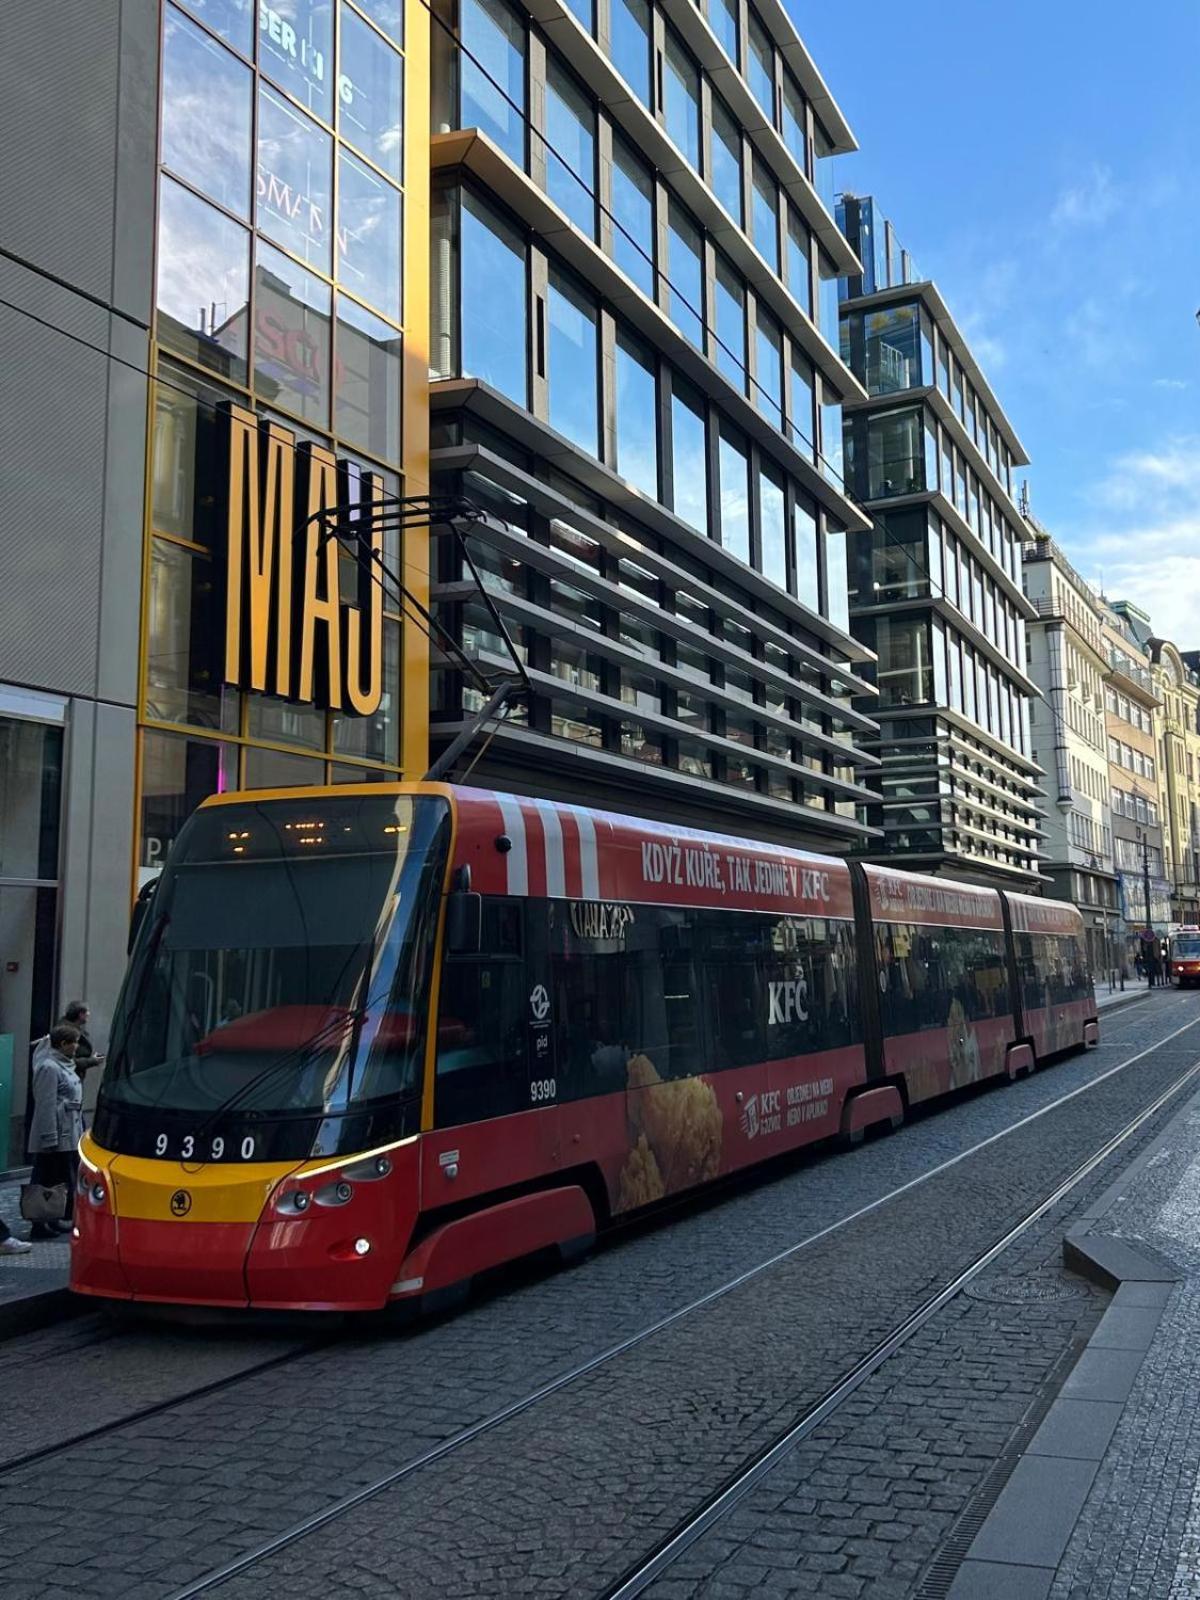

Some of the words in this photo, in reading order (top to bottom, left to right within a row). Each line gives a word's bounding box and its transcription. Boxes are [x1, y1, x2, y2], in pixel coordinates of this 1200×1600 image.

[641, 838, 683, 885] KDYŽ
[727, 855, 752, 893] TAK
[789, 866, 798, 898] V
[801, 868, 830, 902] KFC
[768, 980, 809, 1024] KFC
[536, 1034, 548, 1051] pid
[530, 1078, 556, 1101] 9390
[761, 1090, 781, 1115] KFC
[155, 1132, 256, 1160] 9390
